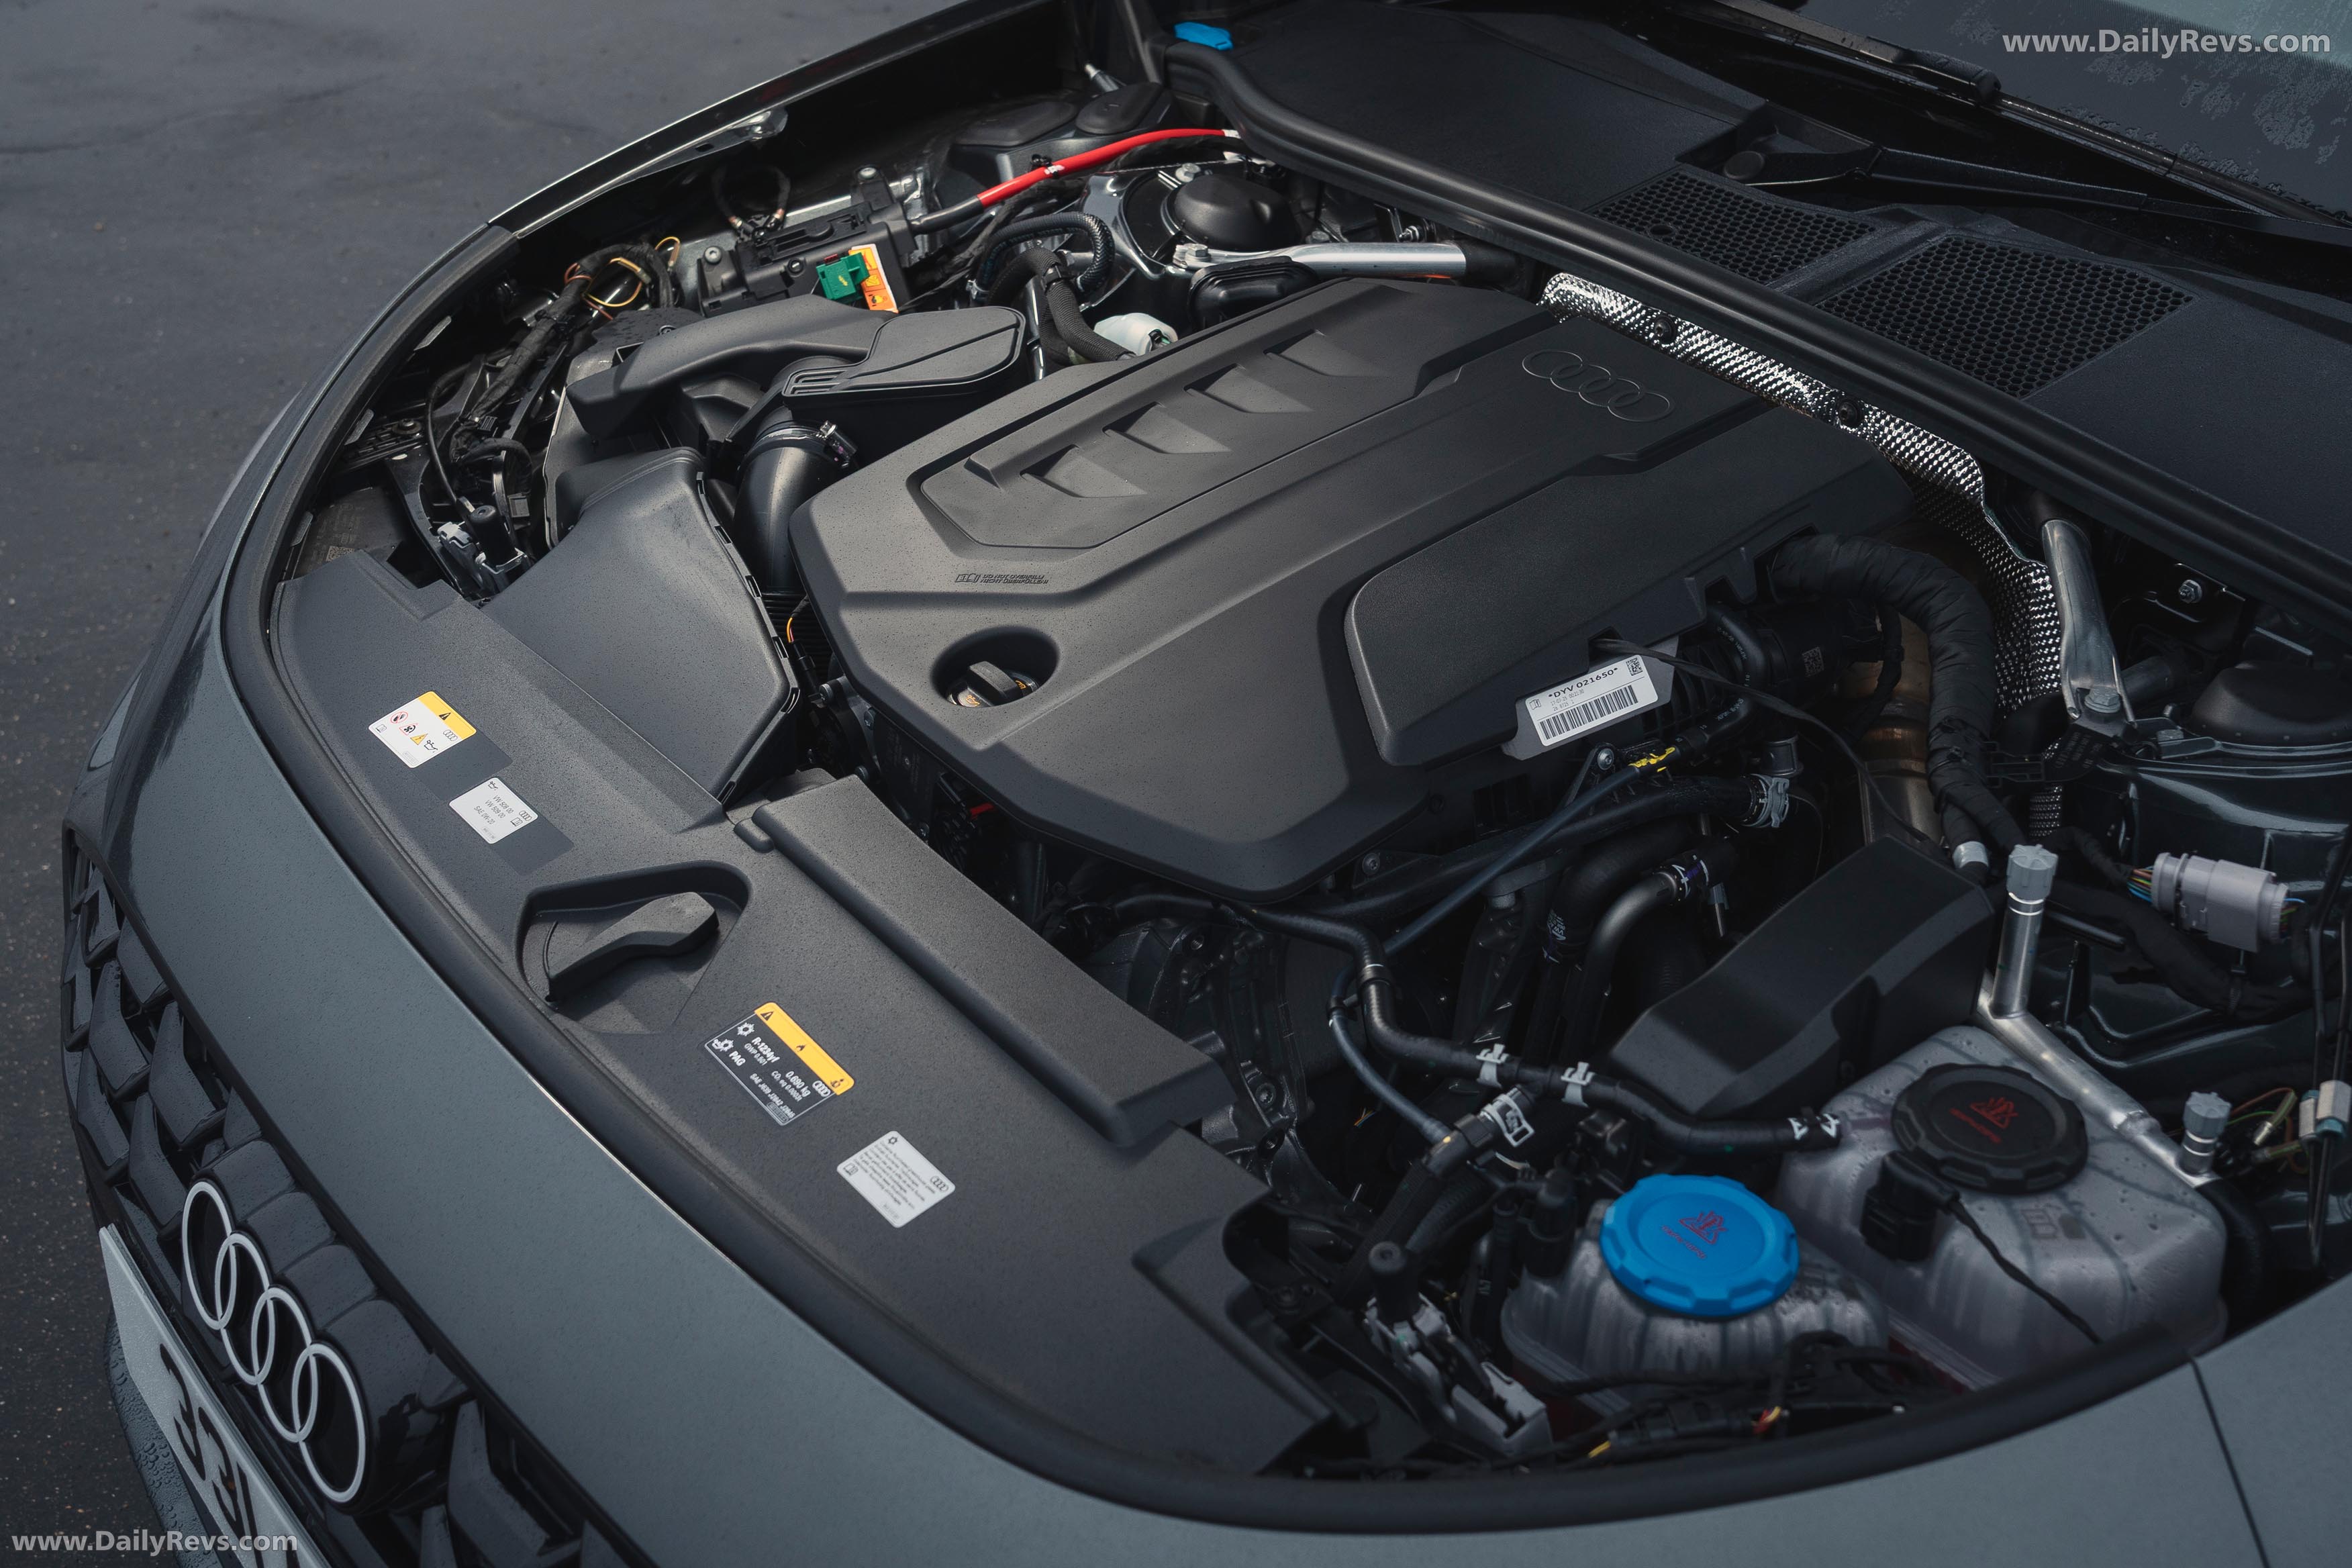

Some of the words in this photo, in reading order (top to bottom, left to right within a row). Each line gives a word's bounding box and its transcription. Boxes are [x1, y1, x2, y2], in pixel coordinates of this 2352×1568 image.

[483, 799, 494, 807] VW
[491, 795, 502, 803] VW
[473, 805, 485, 814] SAE
[742, 1042, 757, 1055] GWP
[728, 1050, 746, 1066] PAG
[749, 1073, 763, 1084] SAE
[749, 1036, 780, 1063] R-1234yf
[784, 1070, 805, 1089] 0.690
[798, 1085, 813, 1097] kg
